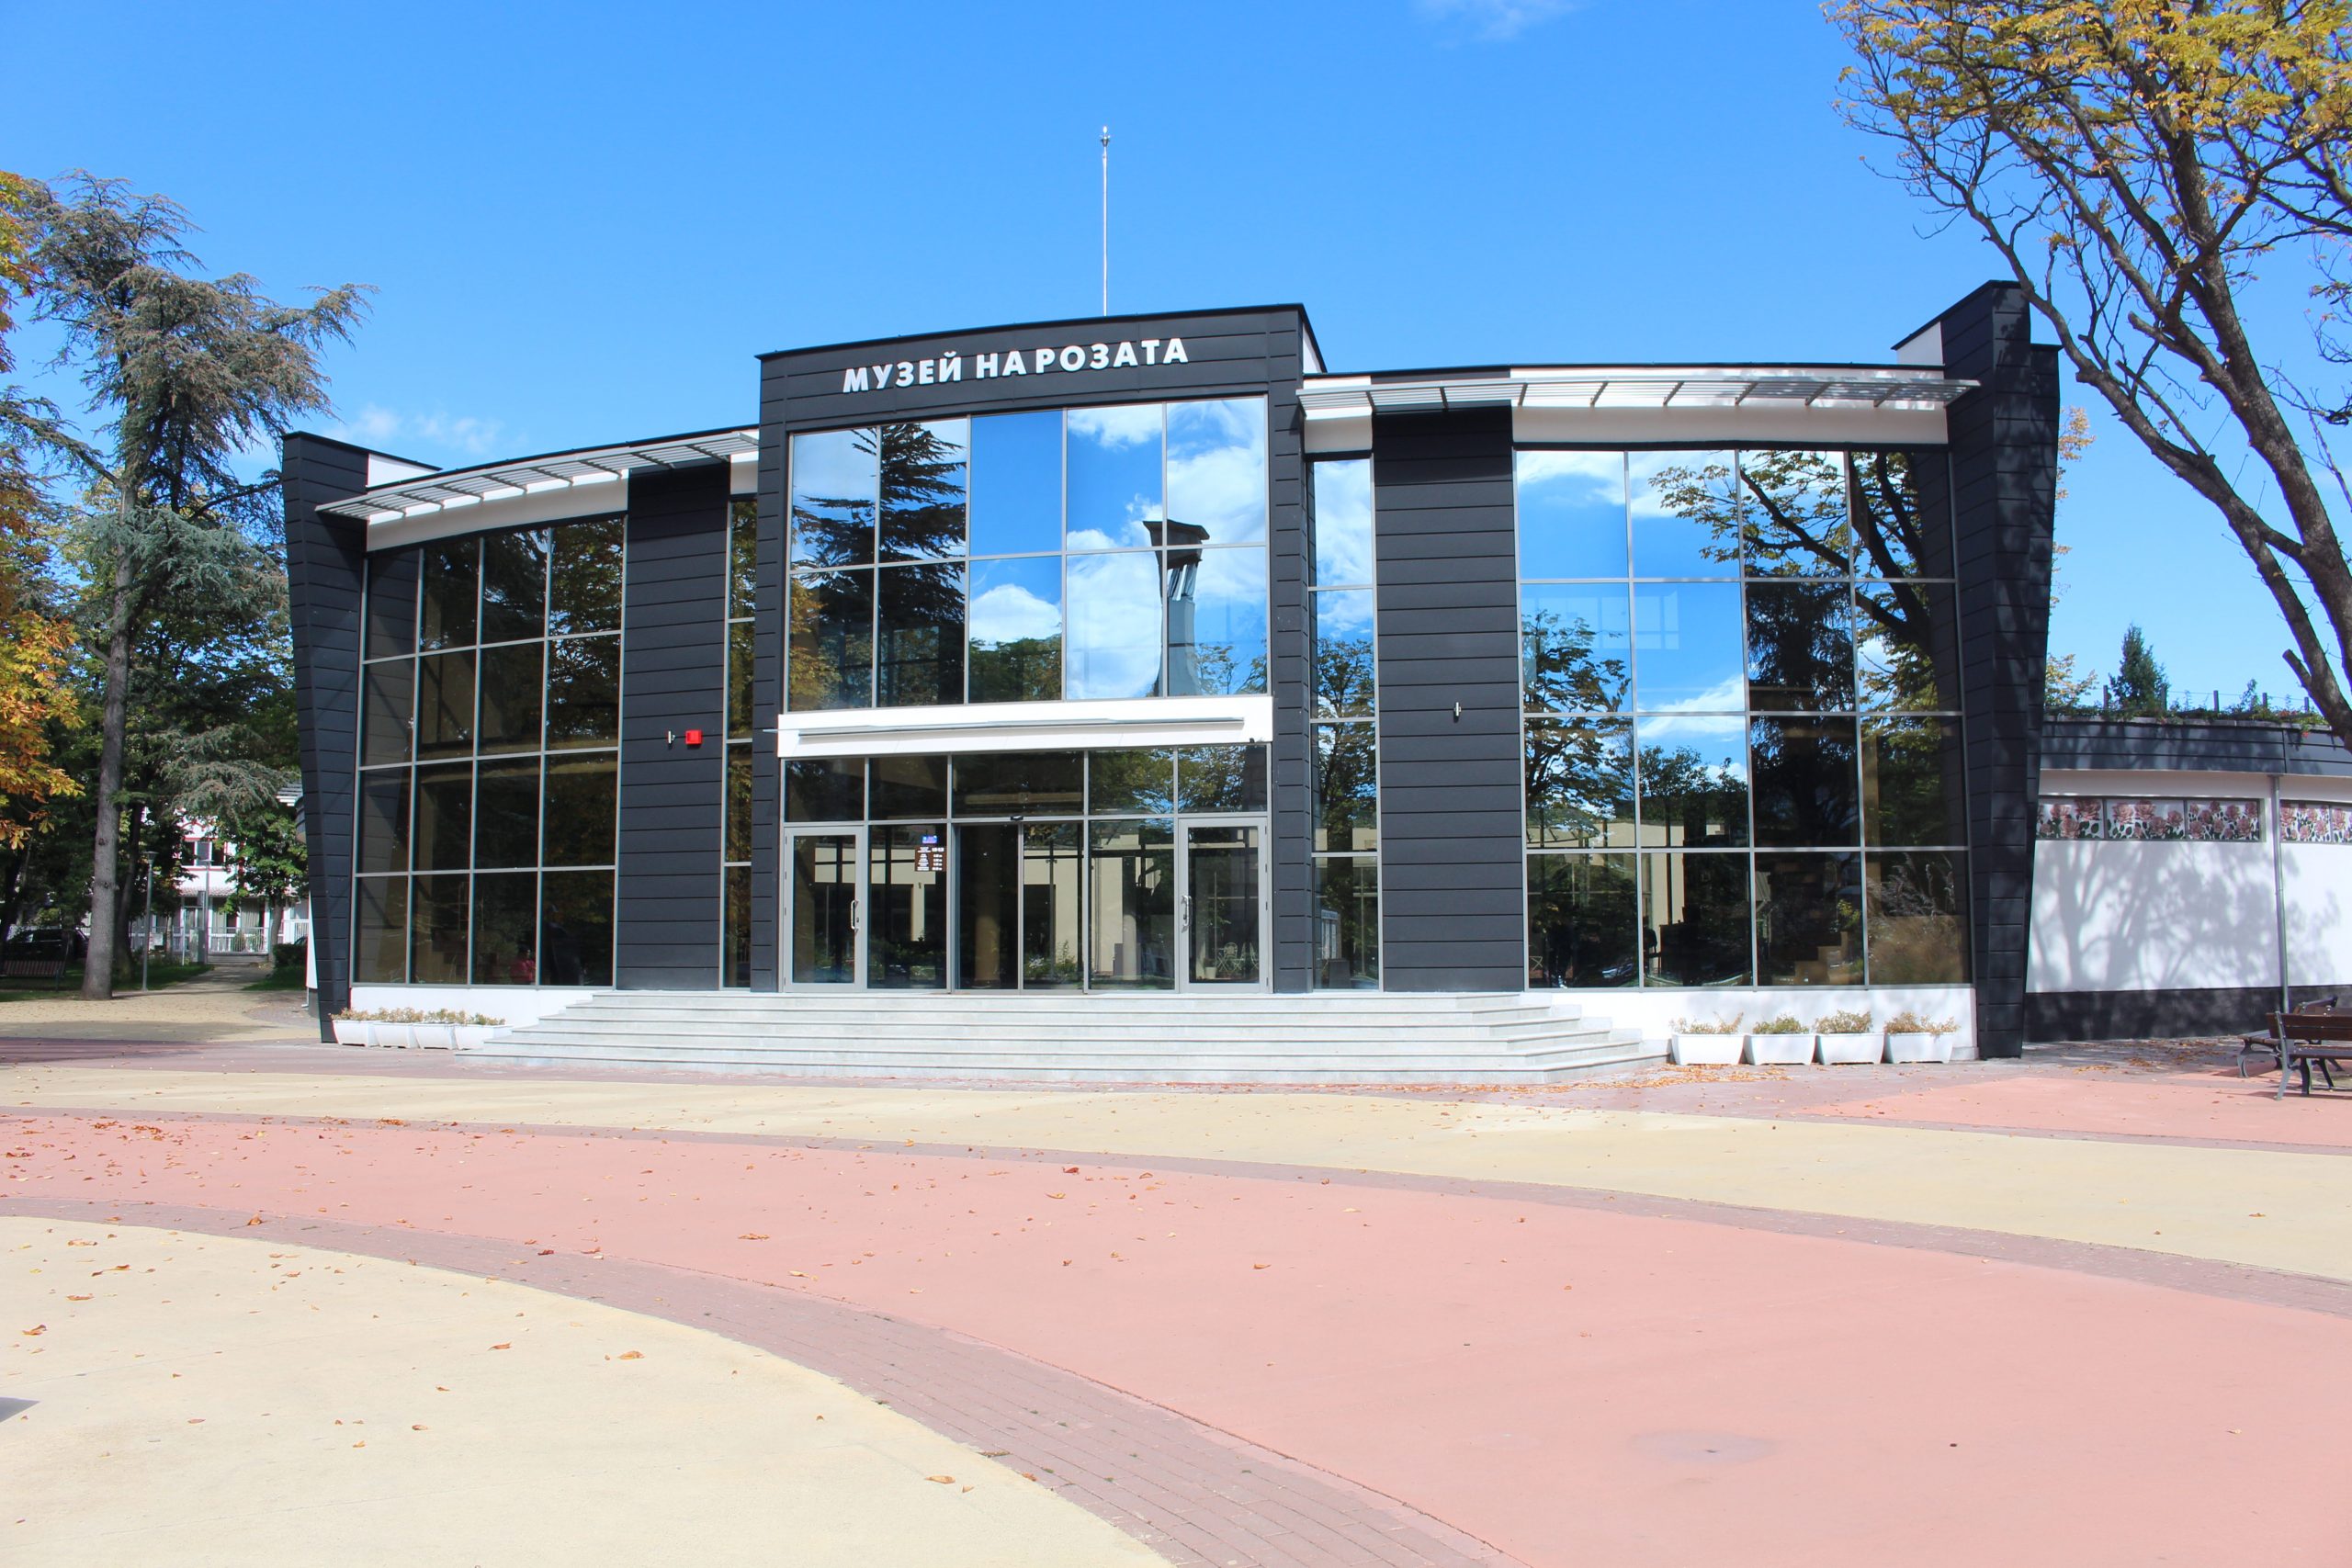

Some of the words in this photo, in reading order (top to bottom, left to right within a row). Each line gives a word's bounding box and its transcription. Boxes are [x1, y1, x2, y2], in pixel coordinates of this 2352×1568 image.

[842, 351, 962, 393] МУЗЕЙ
[976, 351, 1027, 379] НА
[1035, 338, 1188, 374] РОЗАТА
